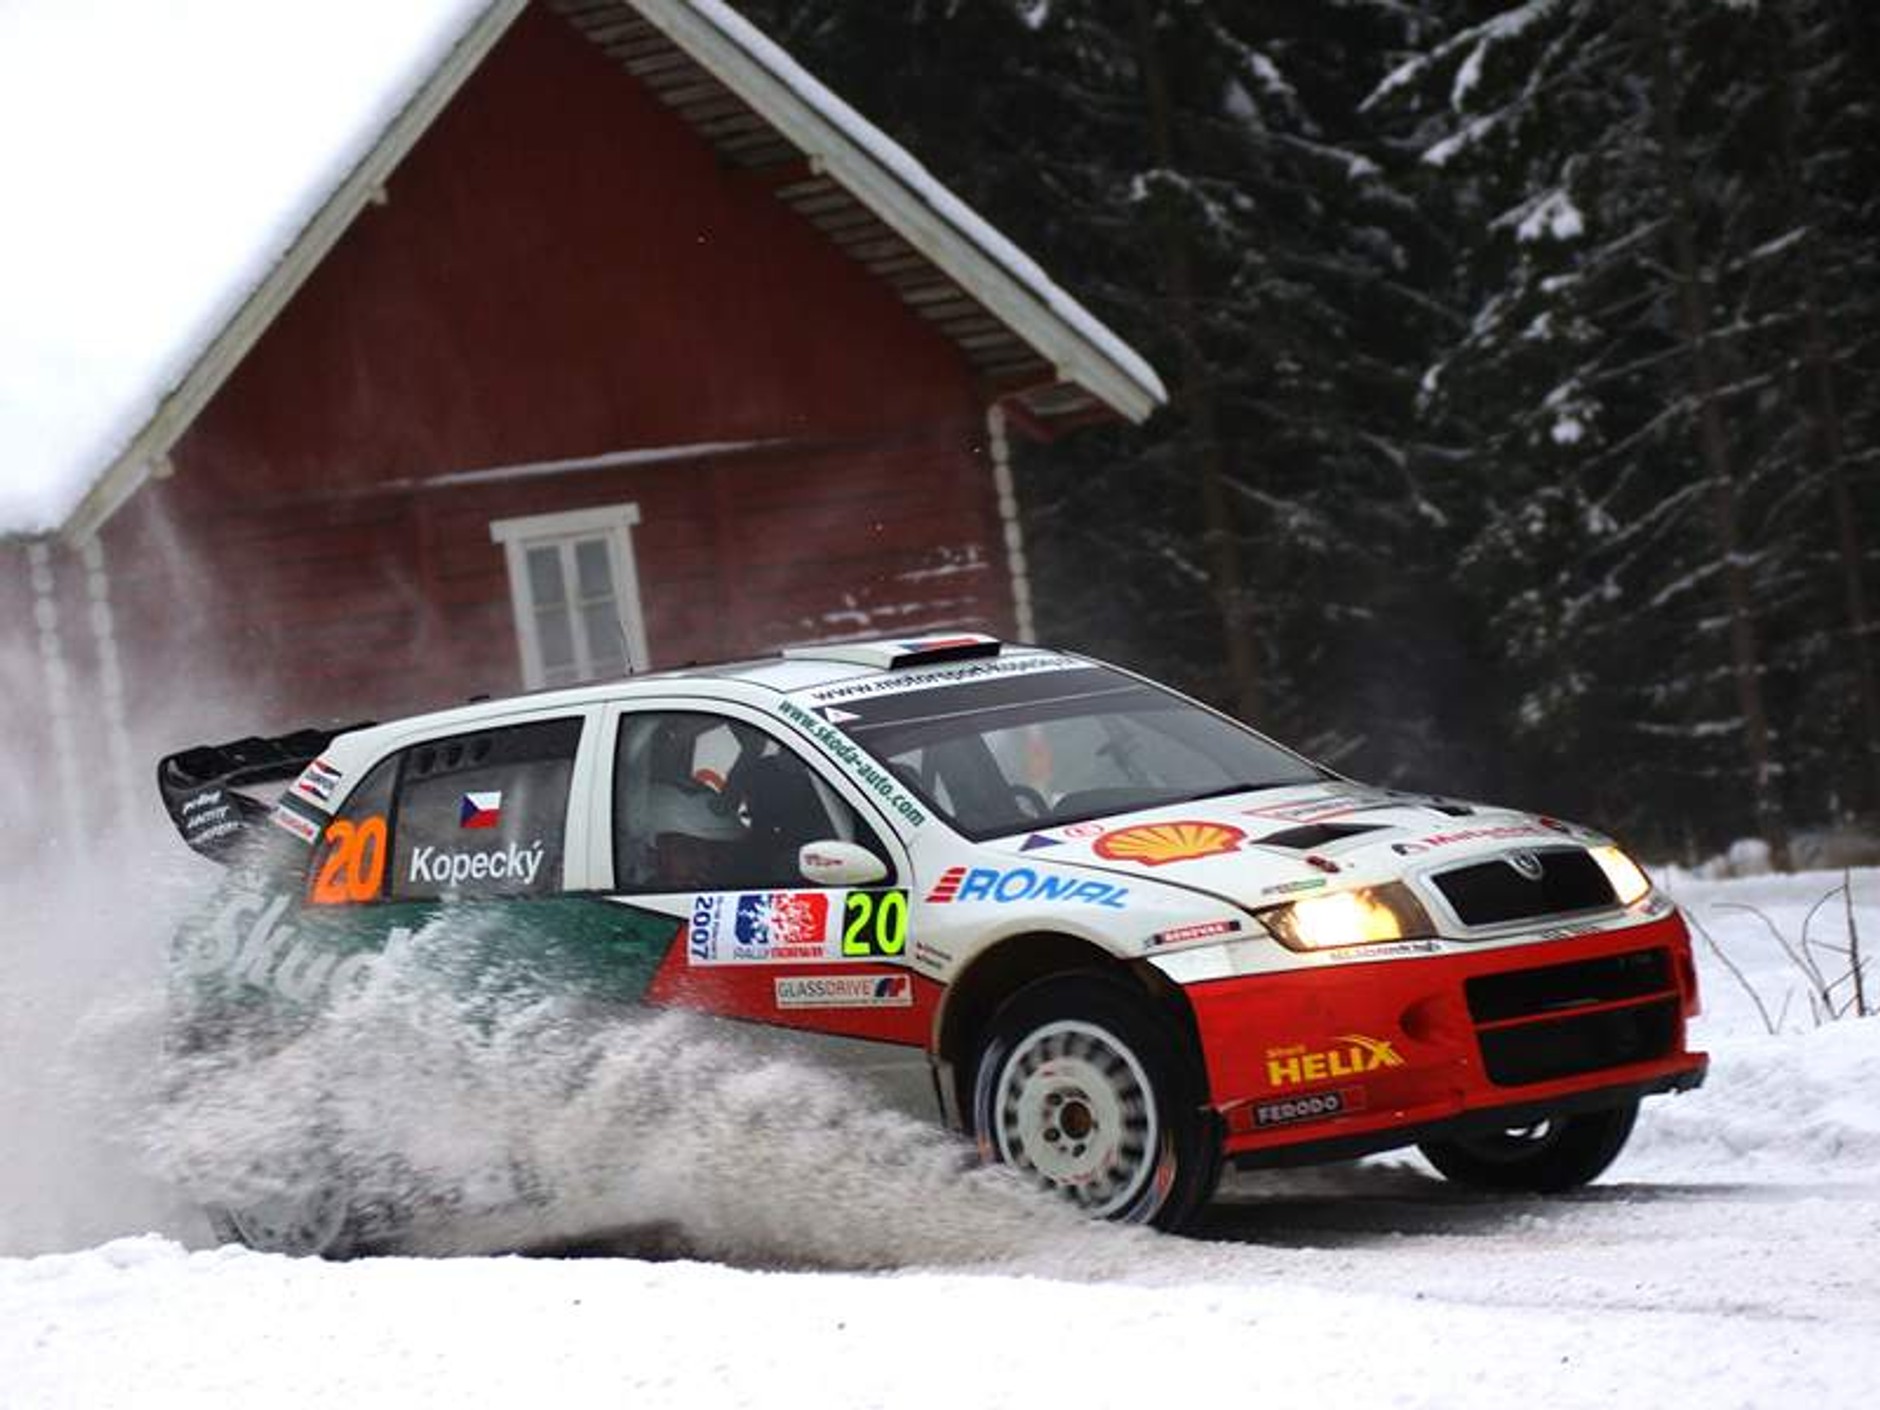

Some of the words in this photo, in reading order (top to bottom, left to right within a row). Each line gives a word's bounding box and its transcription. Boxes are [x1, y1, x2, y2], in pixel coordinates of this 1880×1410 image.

[778, 700, 926, 827] www.skoda-auto.com
[309, 815, 388, 904] 20
[408, 839, 545, 887] Kopecký
[957, 867, 1130, 909] RONAL
[691, 895, 714, 960] 2007
[842, 890, 909, 956] 20
[777, 979, 871, 999] GLASSDRIVE
[1267, 1036, 1404, 1087] HELIX
[1256, 1095, 1339, 1124] FERODO
